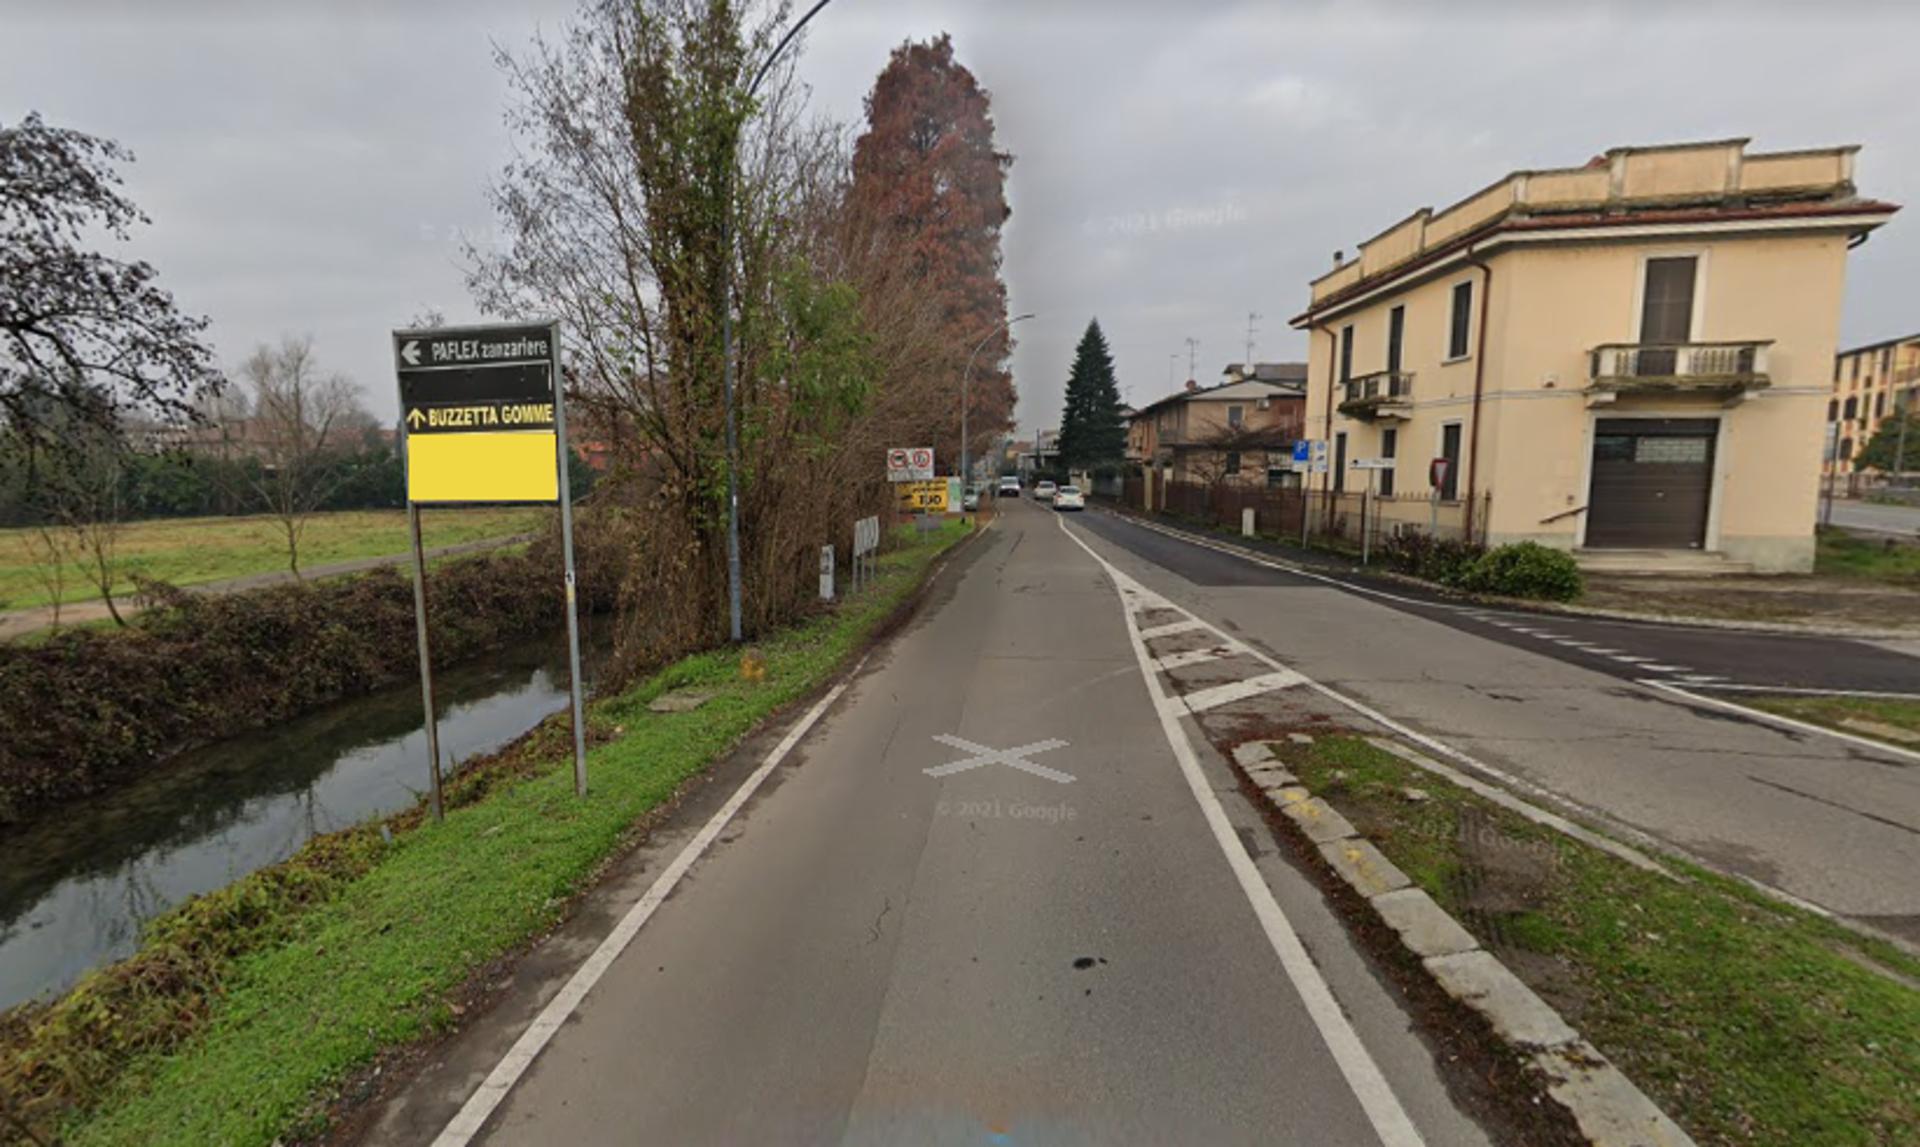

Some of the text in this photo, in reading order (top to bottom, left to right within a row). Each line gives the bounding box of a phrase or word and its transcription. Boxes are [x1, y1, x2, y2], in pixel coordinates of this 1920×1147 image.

[431, 337, 548, 361] PAFLEX zanzariere
[428, 403, 554, 427] BUZZETTA GOMME
[1297, 441, 1306, 452] P
